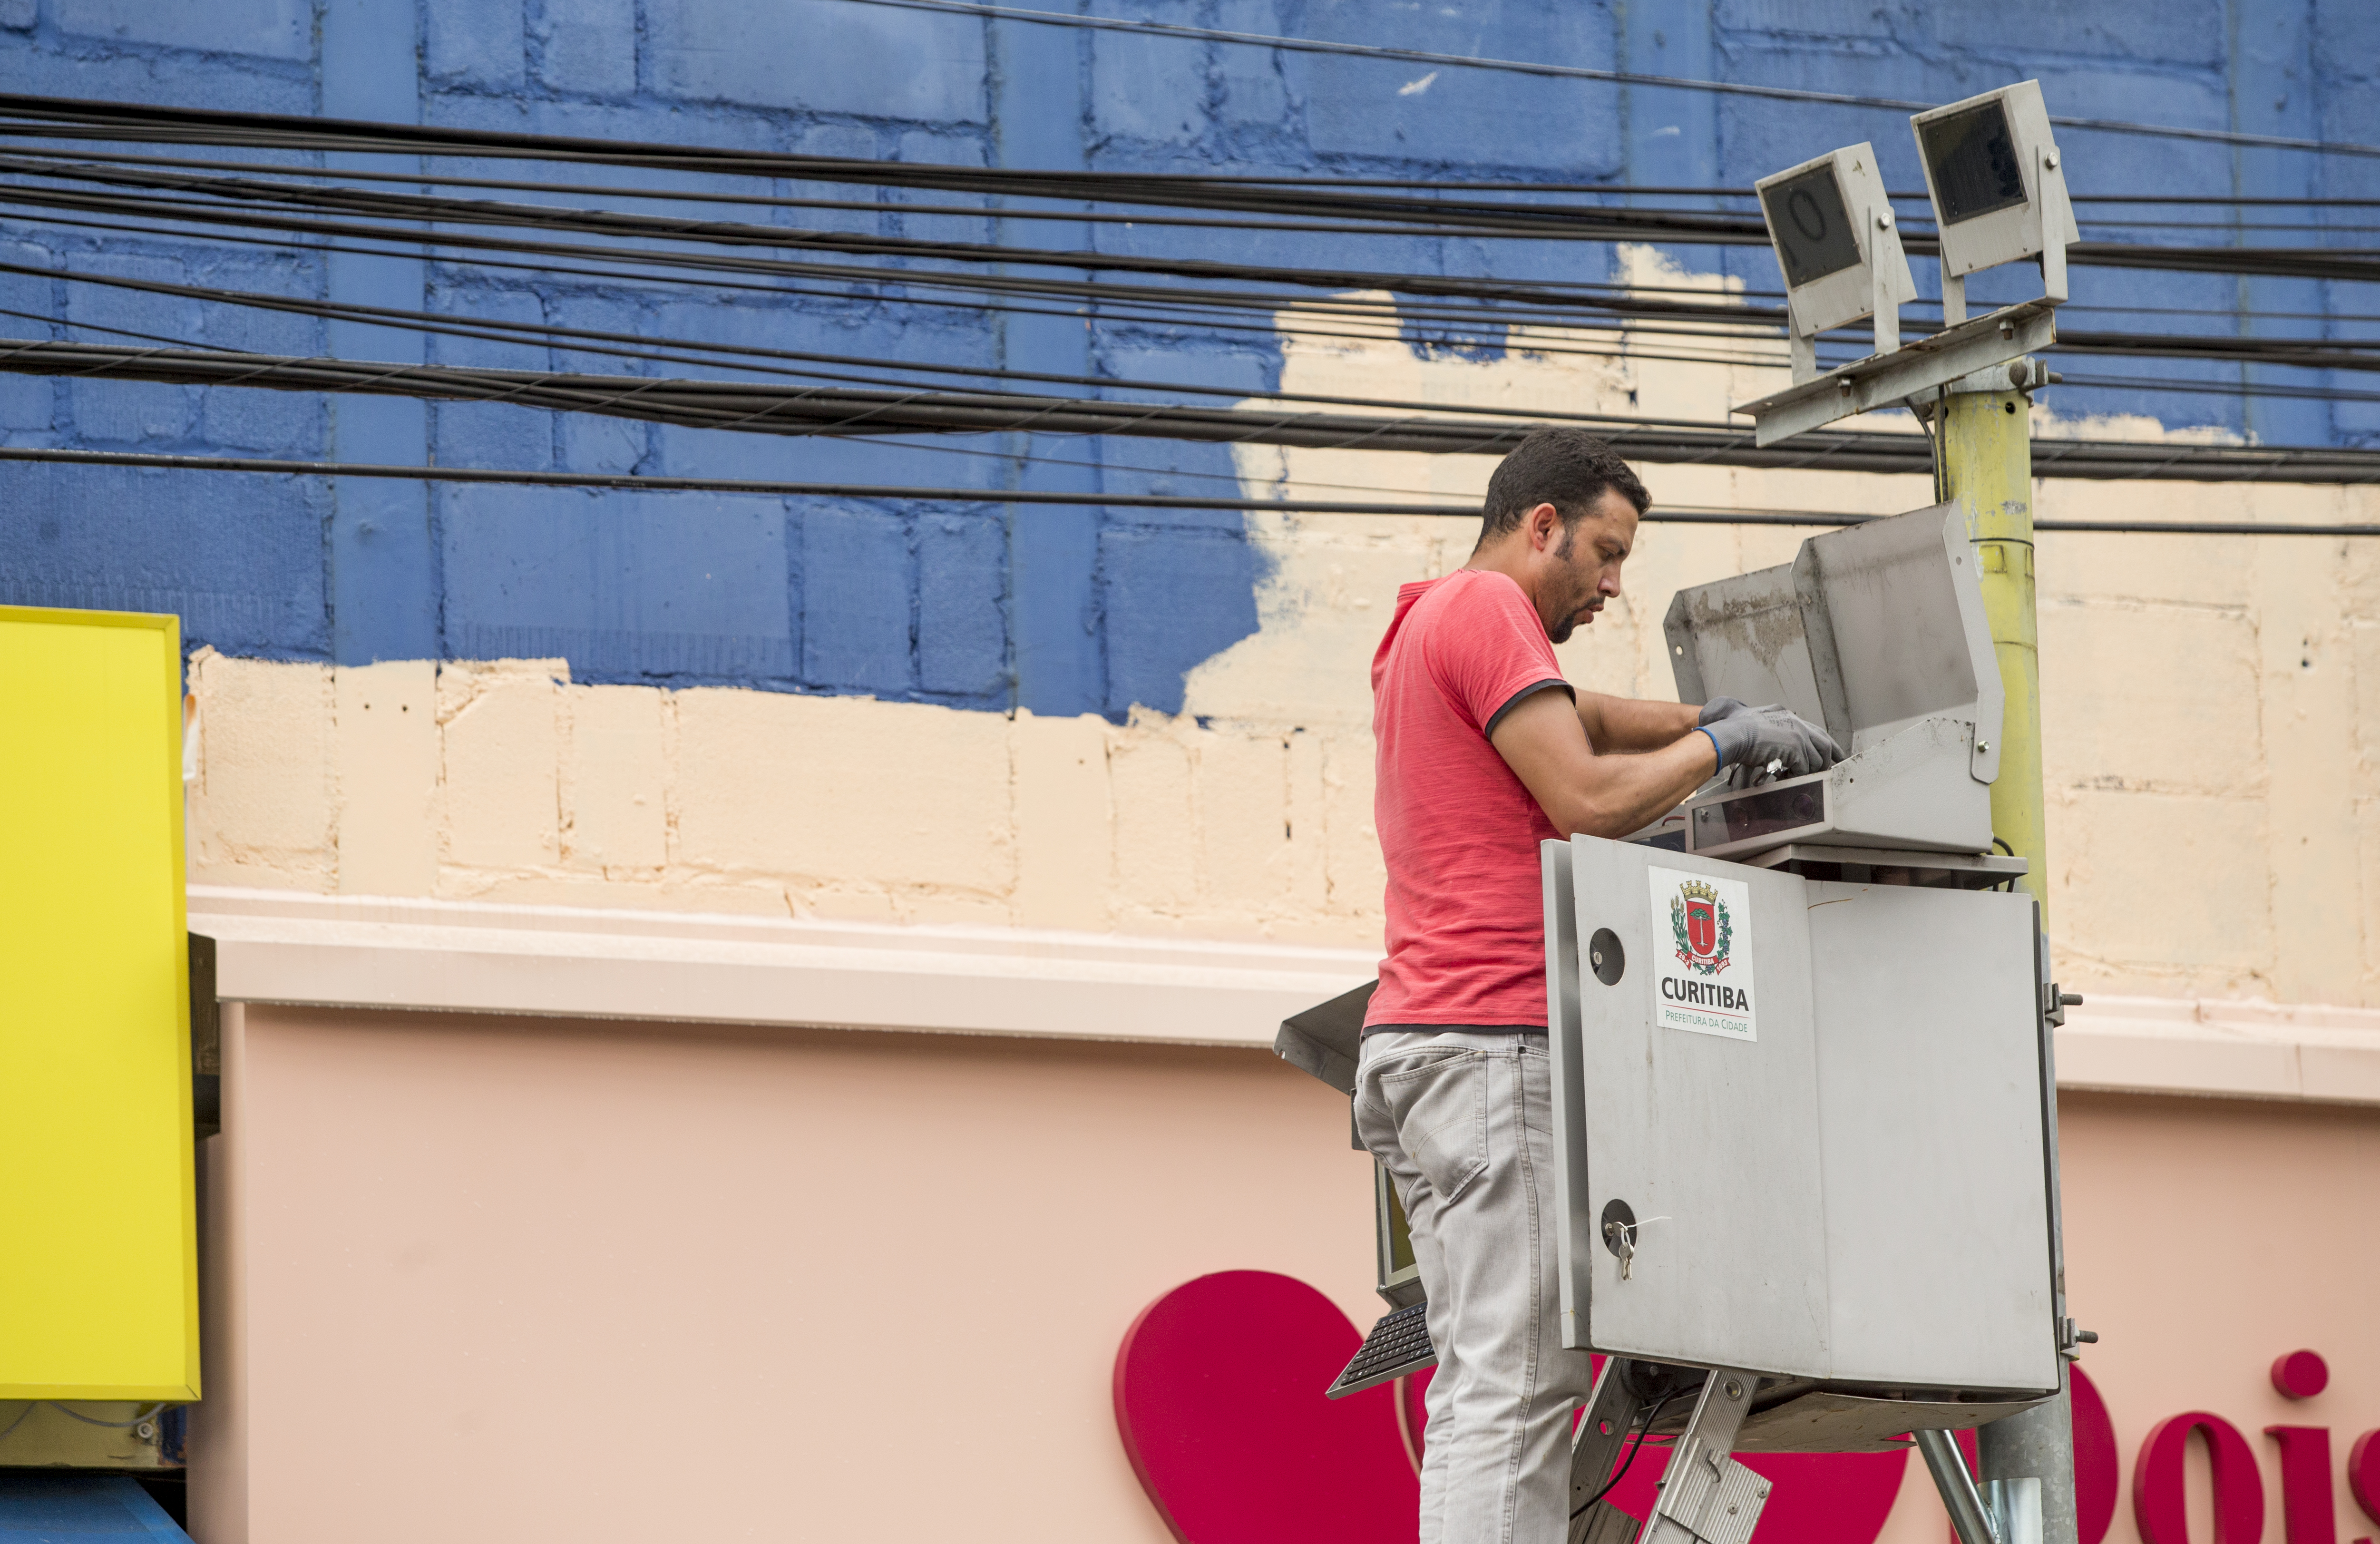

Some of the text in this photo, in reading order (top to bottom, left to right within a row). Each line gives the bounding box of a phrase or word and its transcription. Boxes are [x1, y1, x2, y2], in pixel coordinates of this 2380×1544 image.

[1691, 955, 1714, 964] CURITIBA
[1717, 960, 1727, 971] 1693
[1662, 977, 1749, 1011] CURITIBA
[1709, 1018, 1719, 1028] DA
